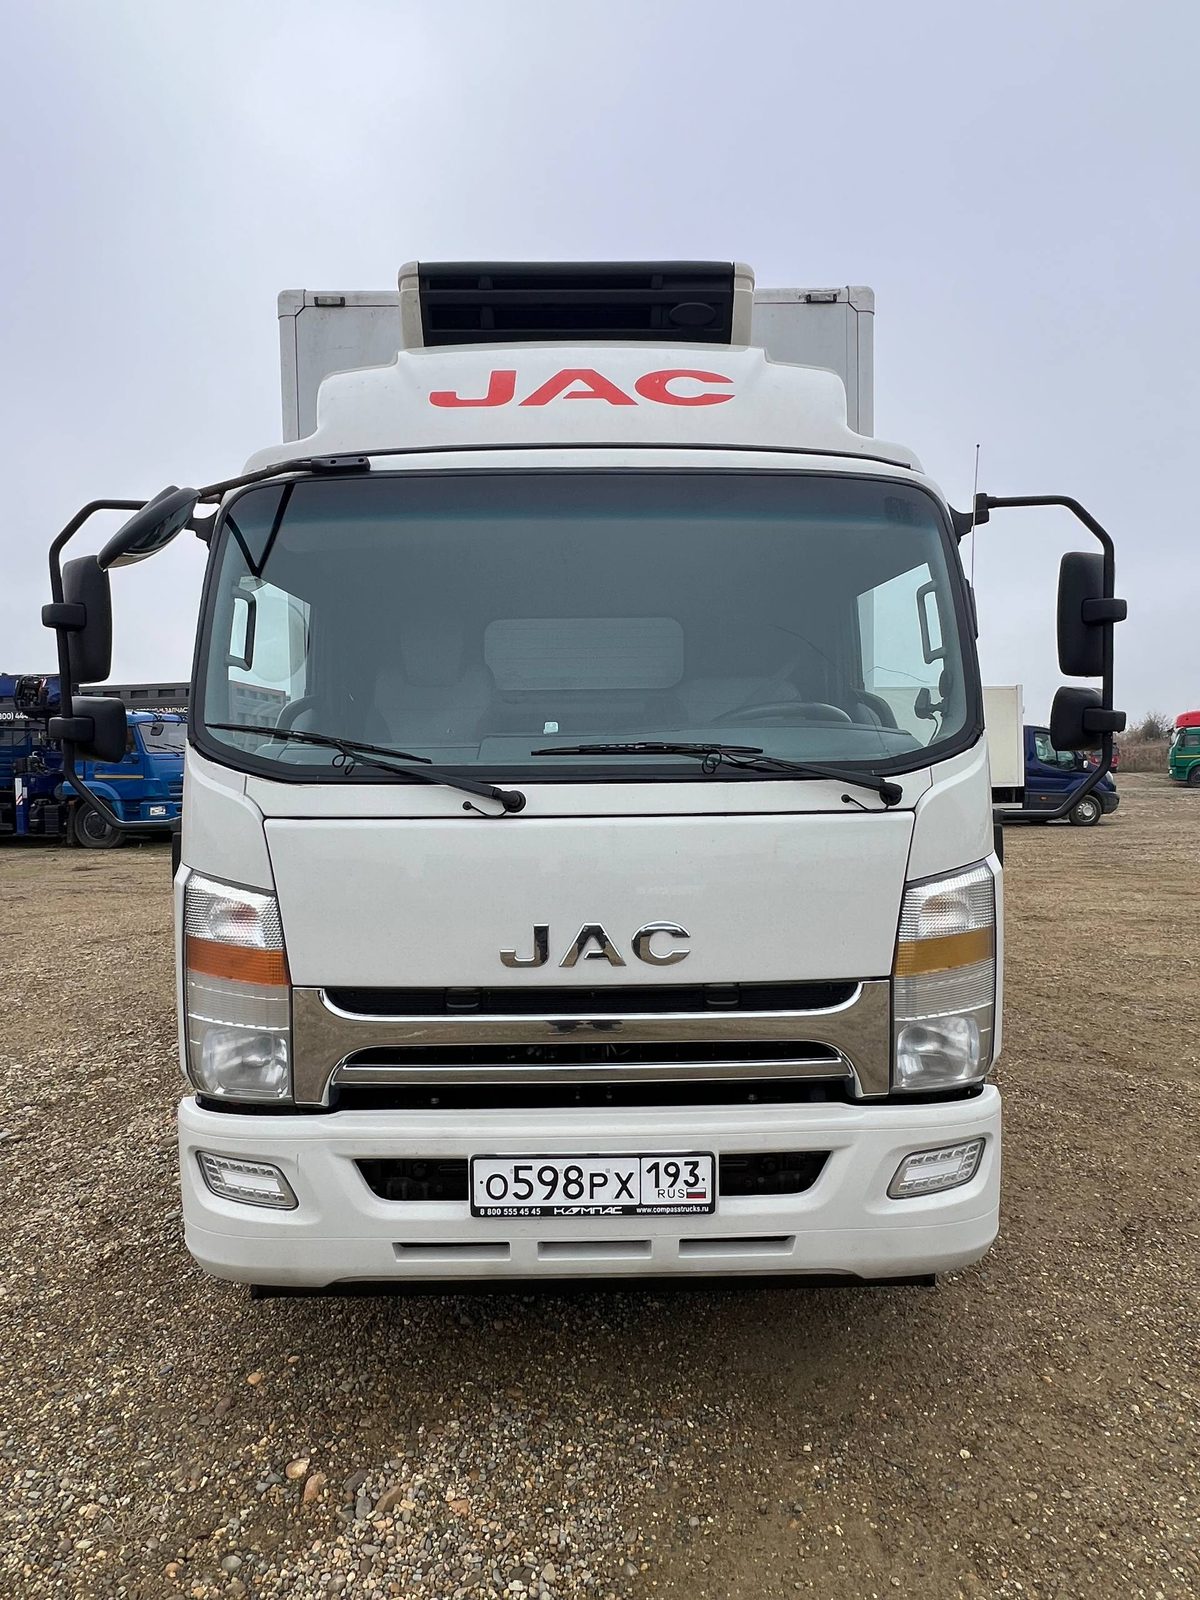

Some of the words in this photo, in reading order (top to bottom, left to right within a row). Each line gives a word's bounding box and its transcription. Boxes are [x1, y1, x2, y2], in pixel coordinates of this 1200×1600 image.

[430, 369, 734, 406] JAC
[500, 921, 691, 968] JAC
[486, 1165, 635, 1201] О598РХ
[646, 1161, 700, 1189] 193
[657, 1188, 686, 1199] RUS
[479, 1207, 485, 1215] 8
[487, 1207, 501, 1215] 800
[503, 1207, 518, 1215] 555
[519, 1207, 529, 1215] 45
[531, 1207, 541, 1215] 45
[636, 1205, 709, 1214] www.compasstrucks.ru
